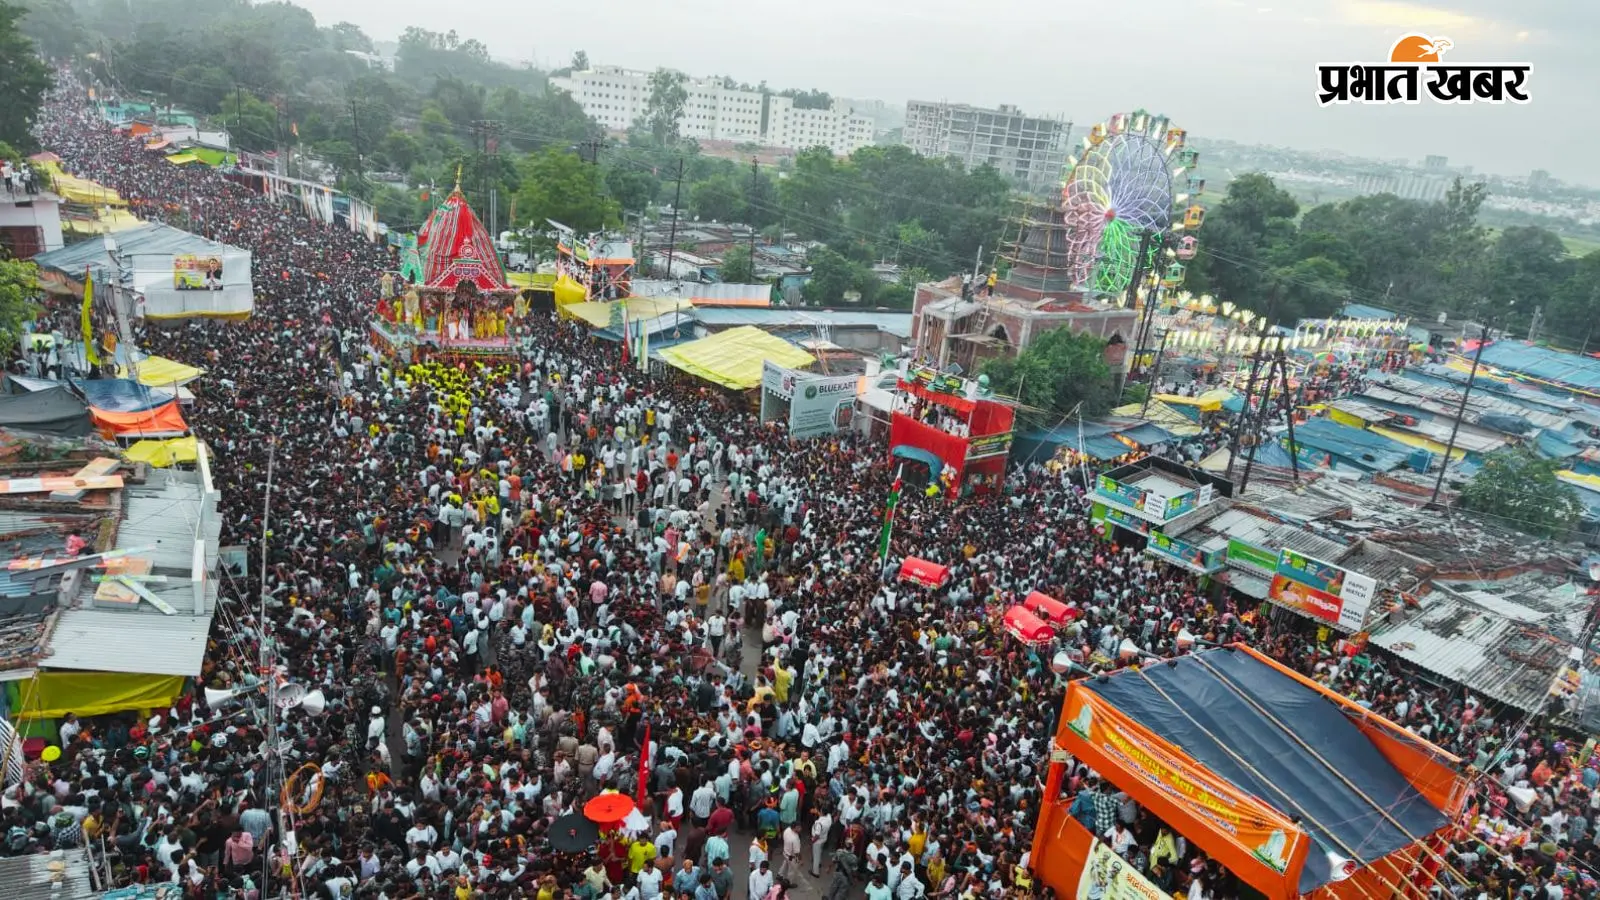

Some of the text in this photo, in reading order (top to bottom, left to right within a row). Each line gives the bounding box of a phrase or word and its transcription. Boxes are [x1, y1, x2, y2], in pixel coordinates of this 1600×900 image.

[819, 381, 858, 394] BLUEKART
[1347, 580, 1368, 592] PAPPU
[1345, 587, 1367, 599] WATCH
[1343, 607, 1363, 618] PAPPU
